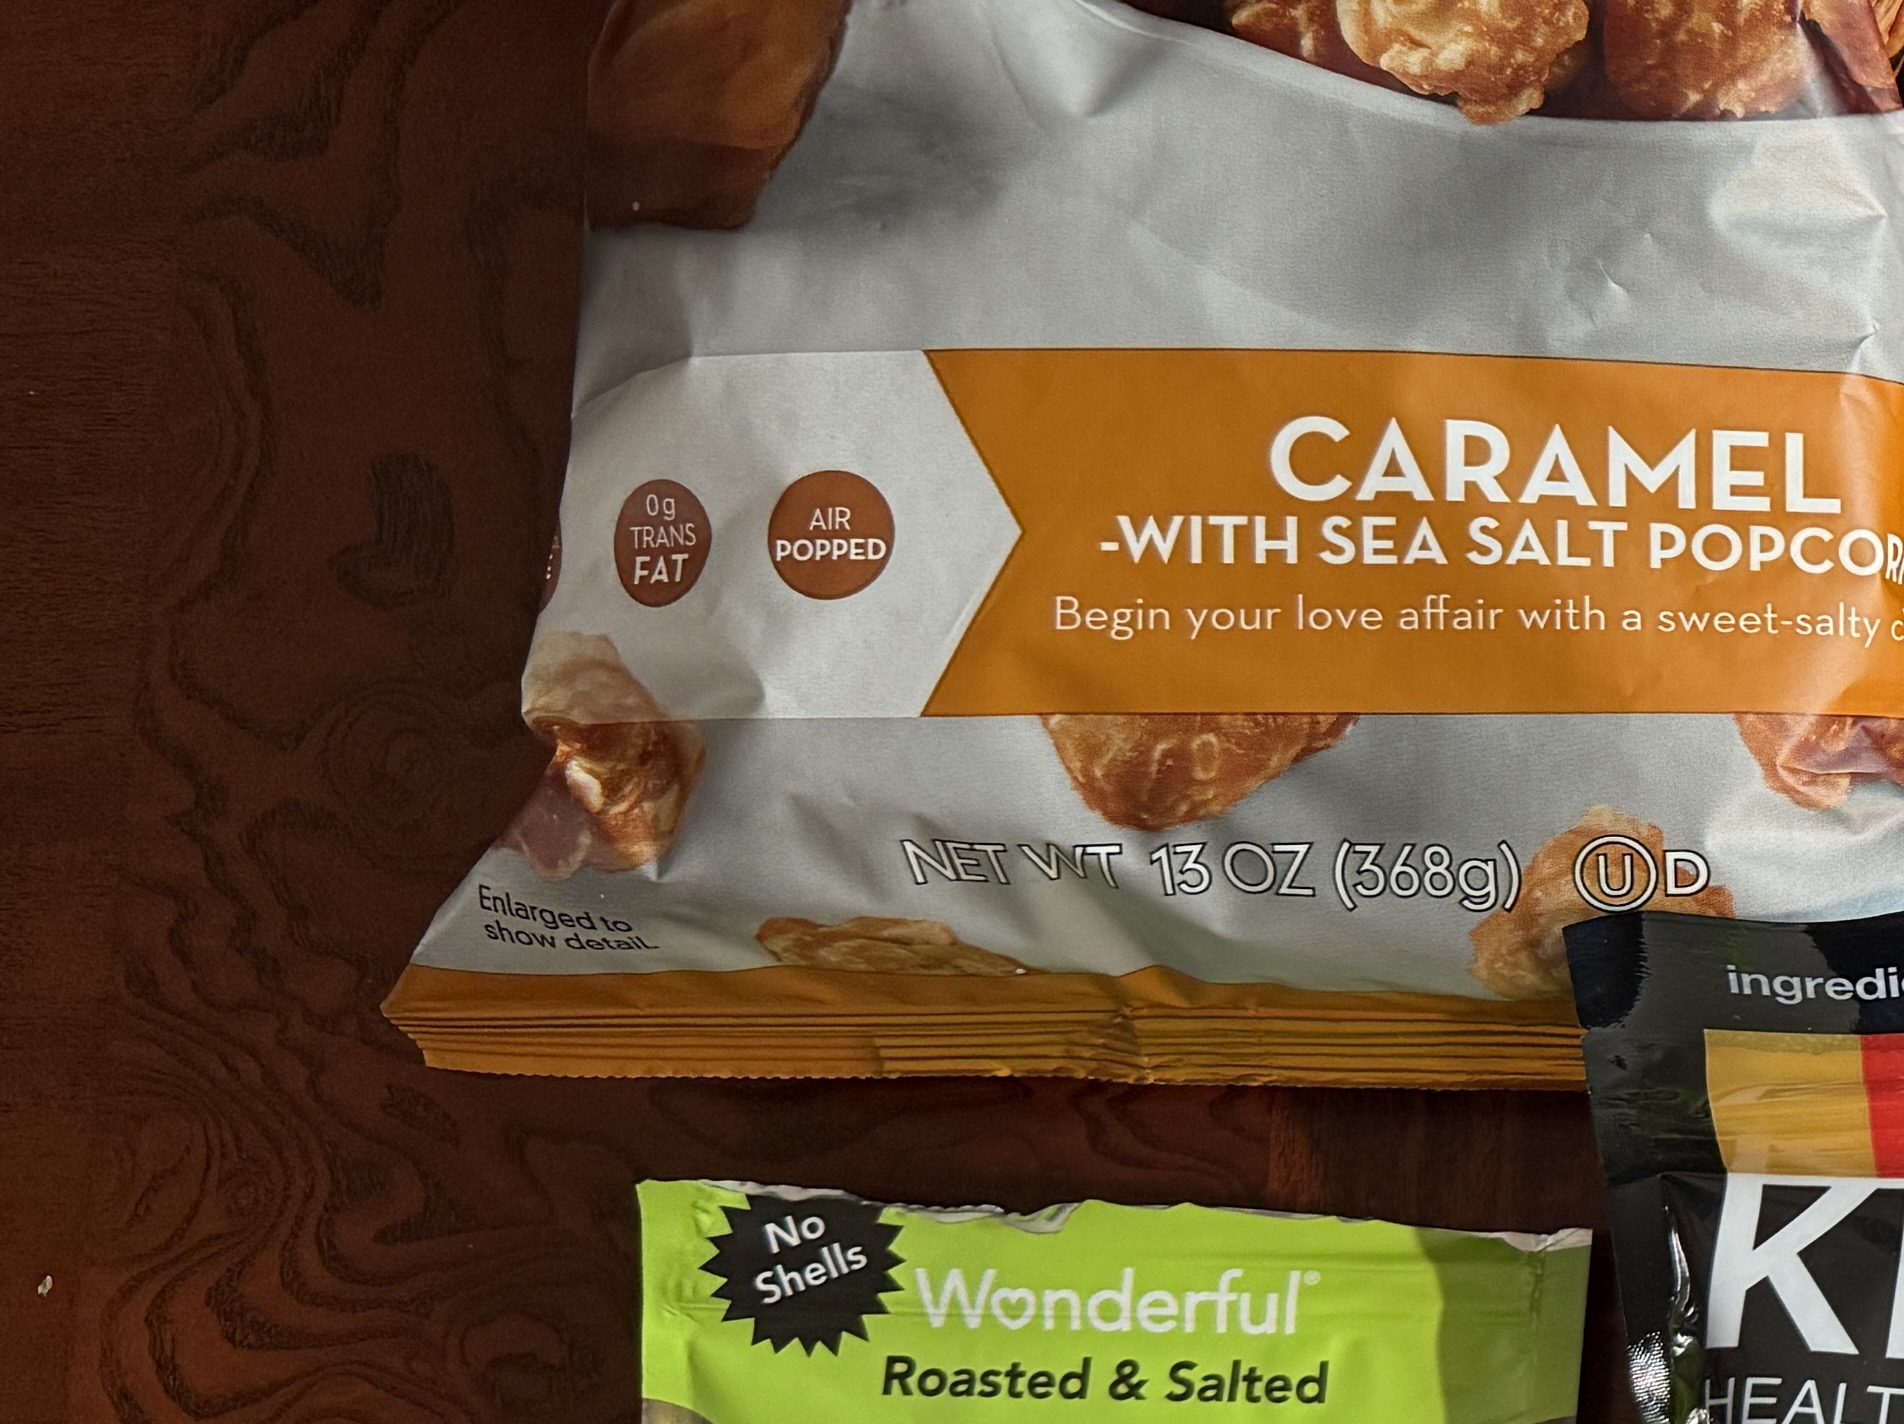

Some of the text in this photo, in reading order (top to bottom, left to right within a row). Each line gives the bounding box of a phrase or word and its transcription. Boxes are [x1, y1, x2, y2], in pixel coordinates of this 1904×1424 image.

[1270, 415, 1842, 516] CARAMEL
[630, 523, 696, 549] TRANS
[809, 506, 850, 530] AIR
[775, 537, 887, 563] POPPED
[1319, 516, 1449, 567] SEA
[1467, 518, 1629, 569] SALT
[633, 553, 689, 585] FAT
[1053, 596, 1881, 648] Begin your love affair with sweet-salty
[900, 839, 1522, 912] NET WT 13 OZ (368g)
[478, 885, 633, 933] Enlarged to
[484, 919, 555, 948] show
[764, 1212, 826, 1255] No
[755, 1237, 868, 1305] Shells
[881, 1355, 1329, 1404] Roasted & Salted
